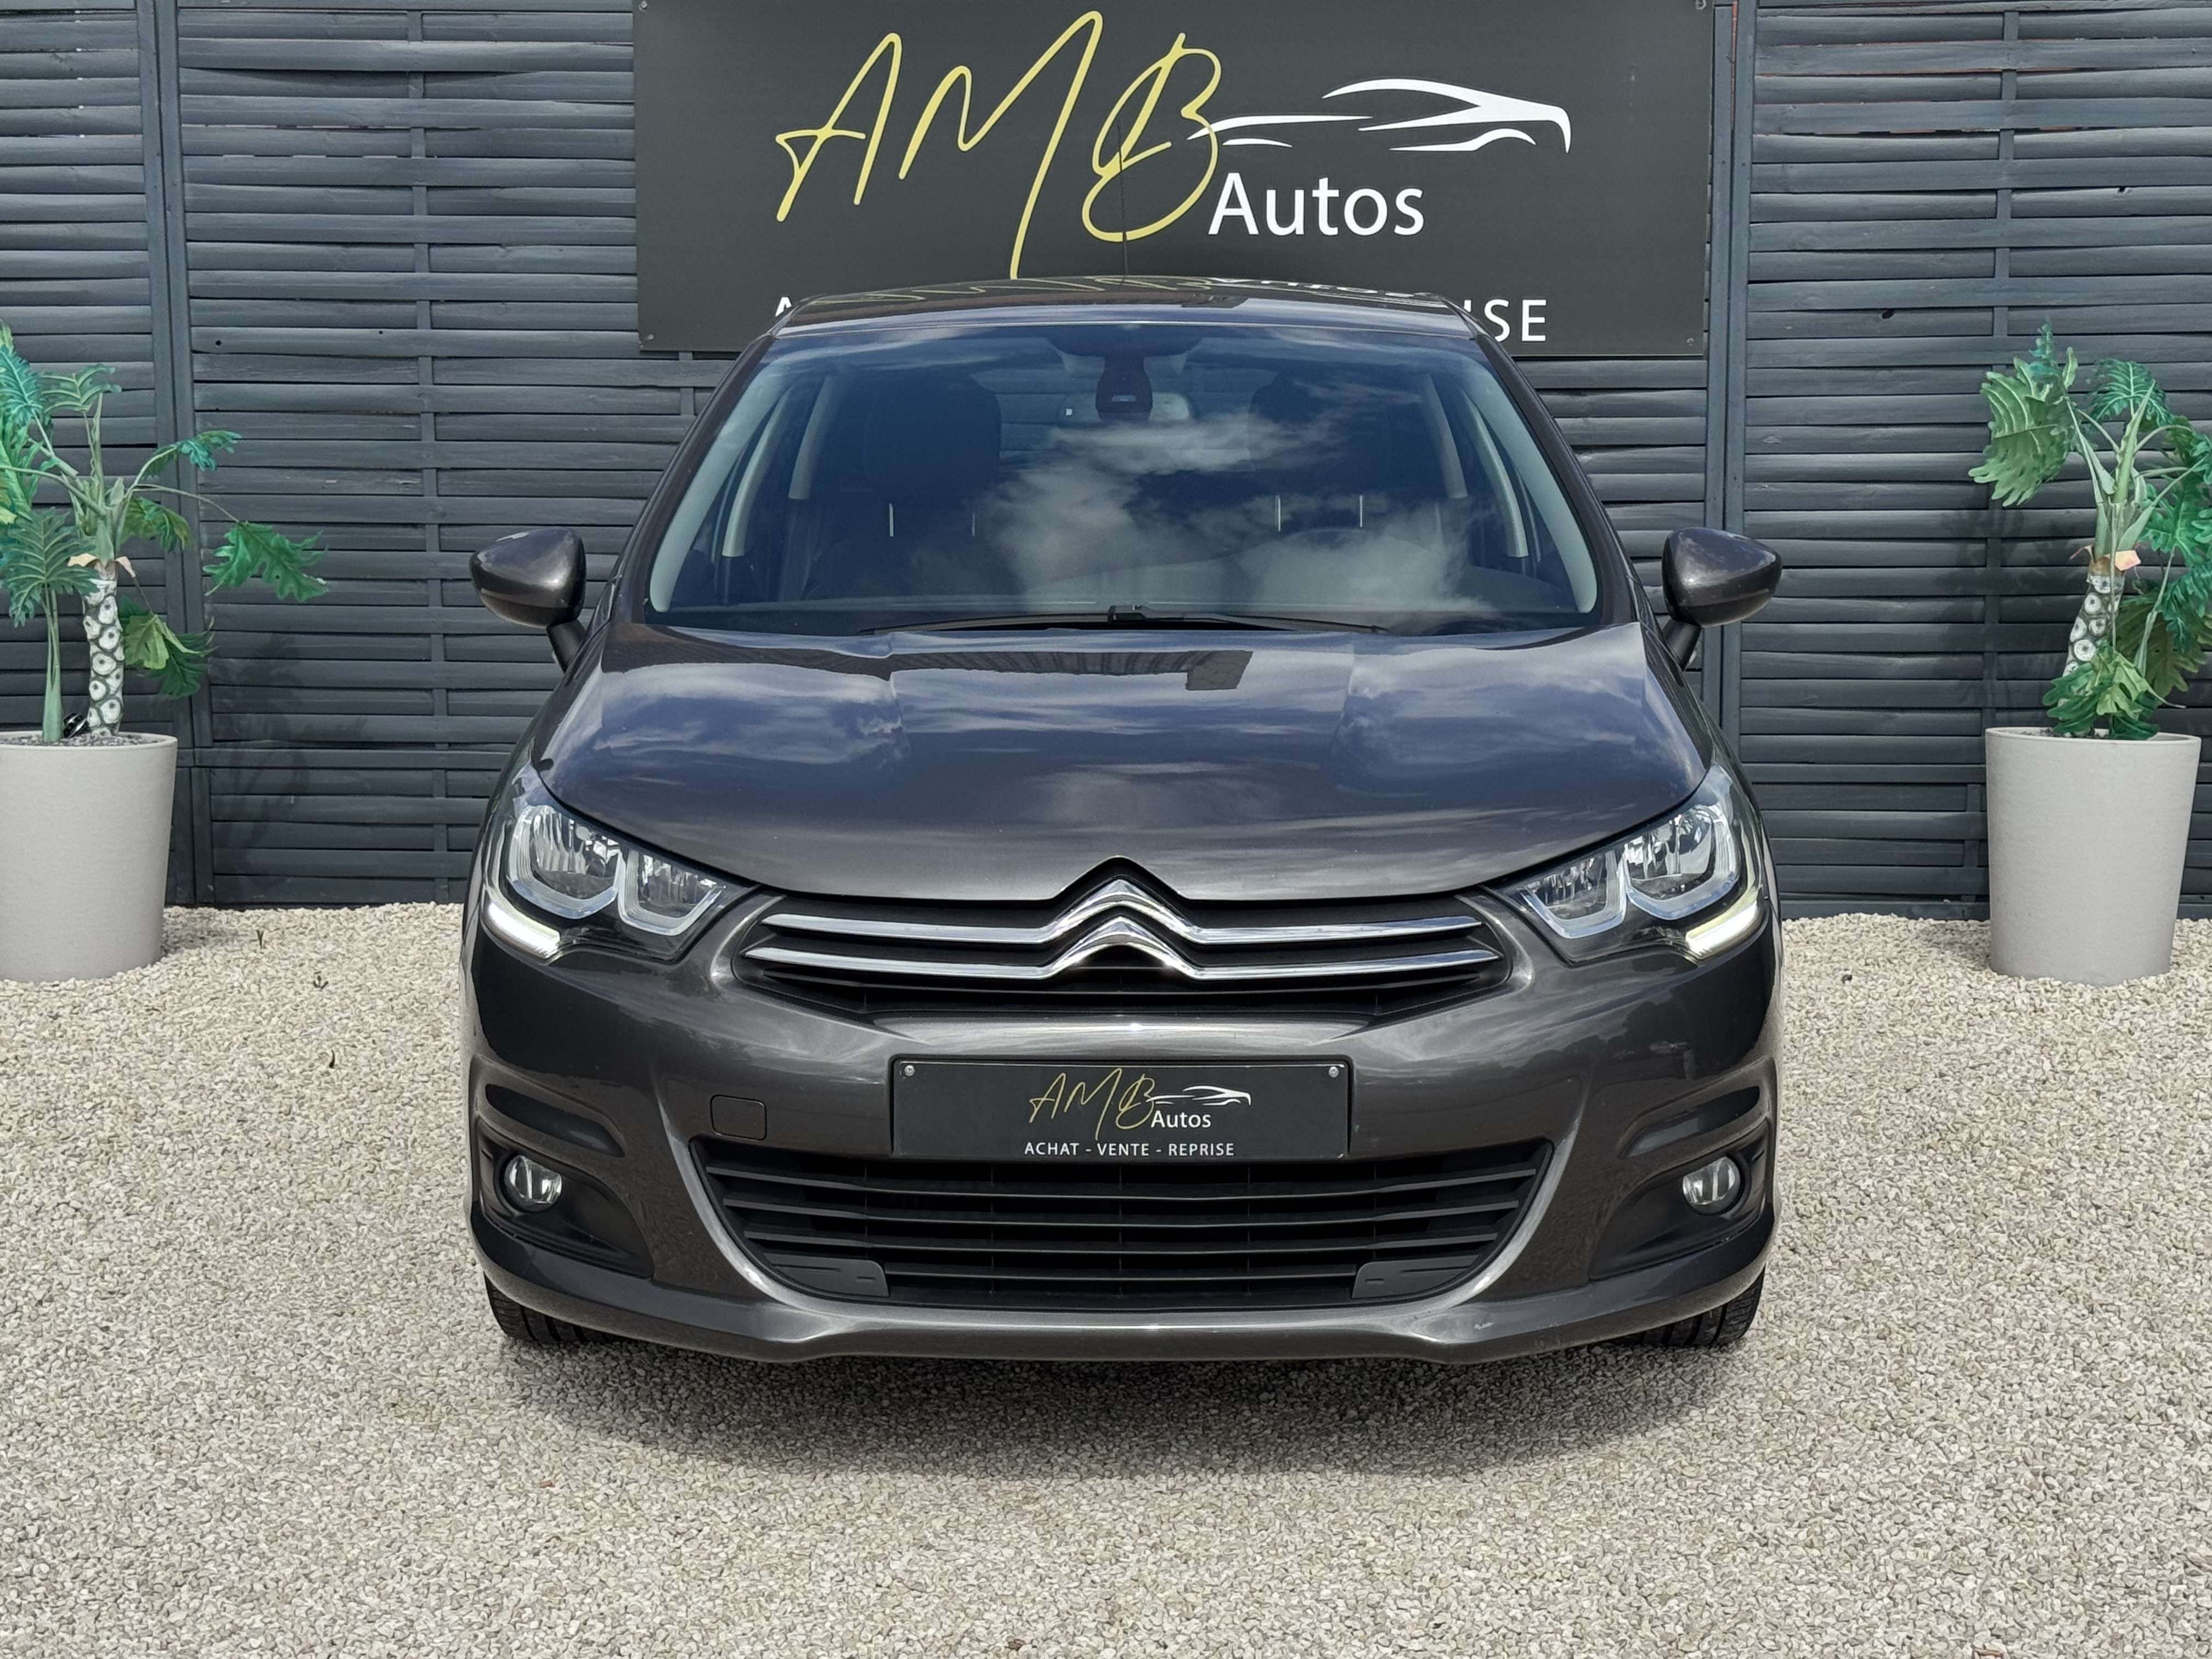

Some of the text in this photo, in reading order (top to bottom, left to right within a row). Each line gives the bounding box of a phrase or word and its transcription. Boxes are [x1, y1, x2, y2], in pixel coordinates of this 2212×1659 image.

[776, 10, 1425, 279] AMB Autos
[1150, 1110, 1212, 1128] Autos
[1024, 1142, 1080, 1155] ACHAT
[1097, 1143, 1150, 1156] VENTE
[1169, 1143, 1235, 1156] REPRISE
